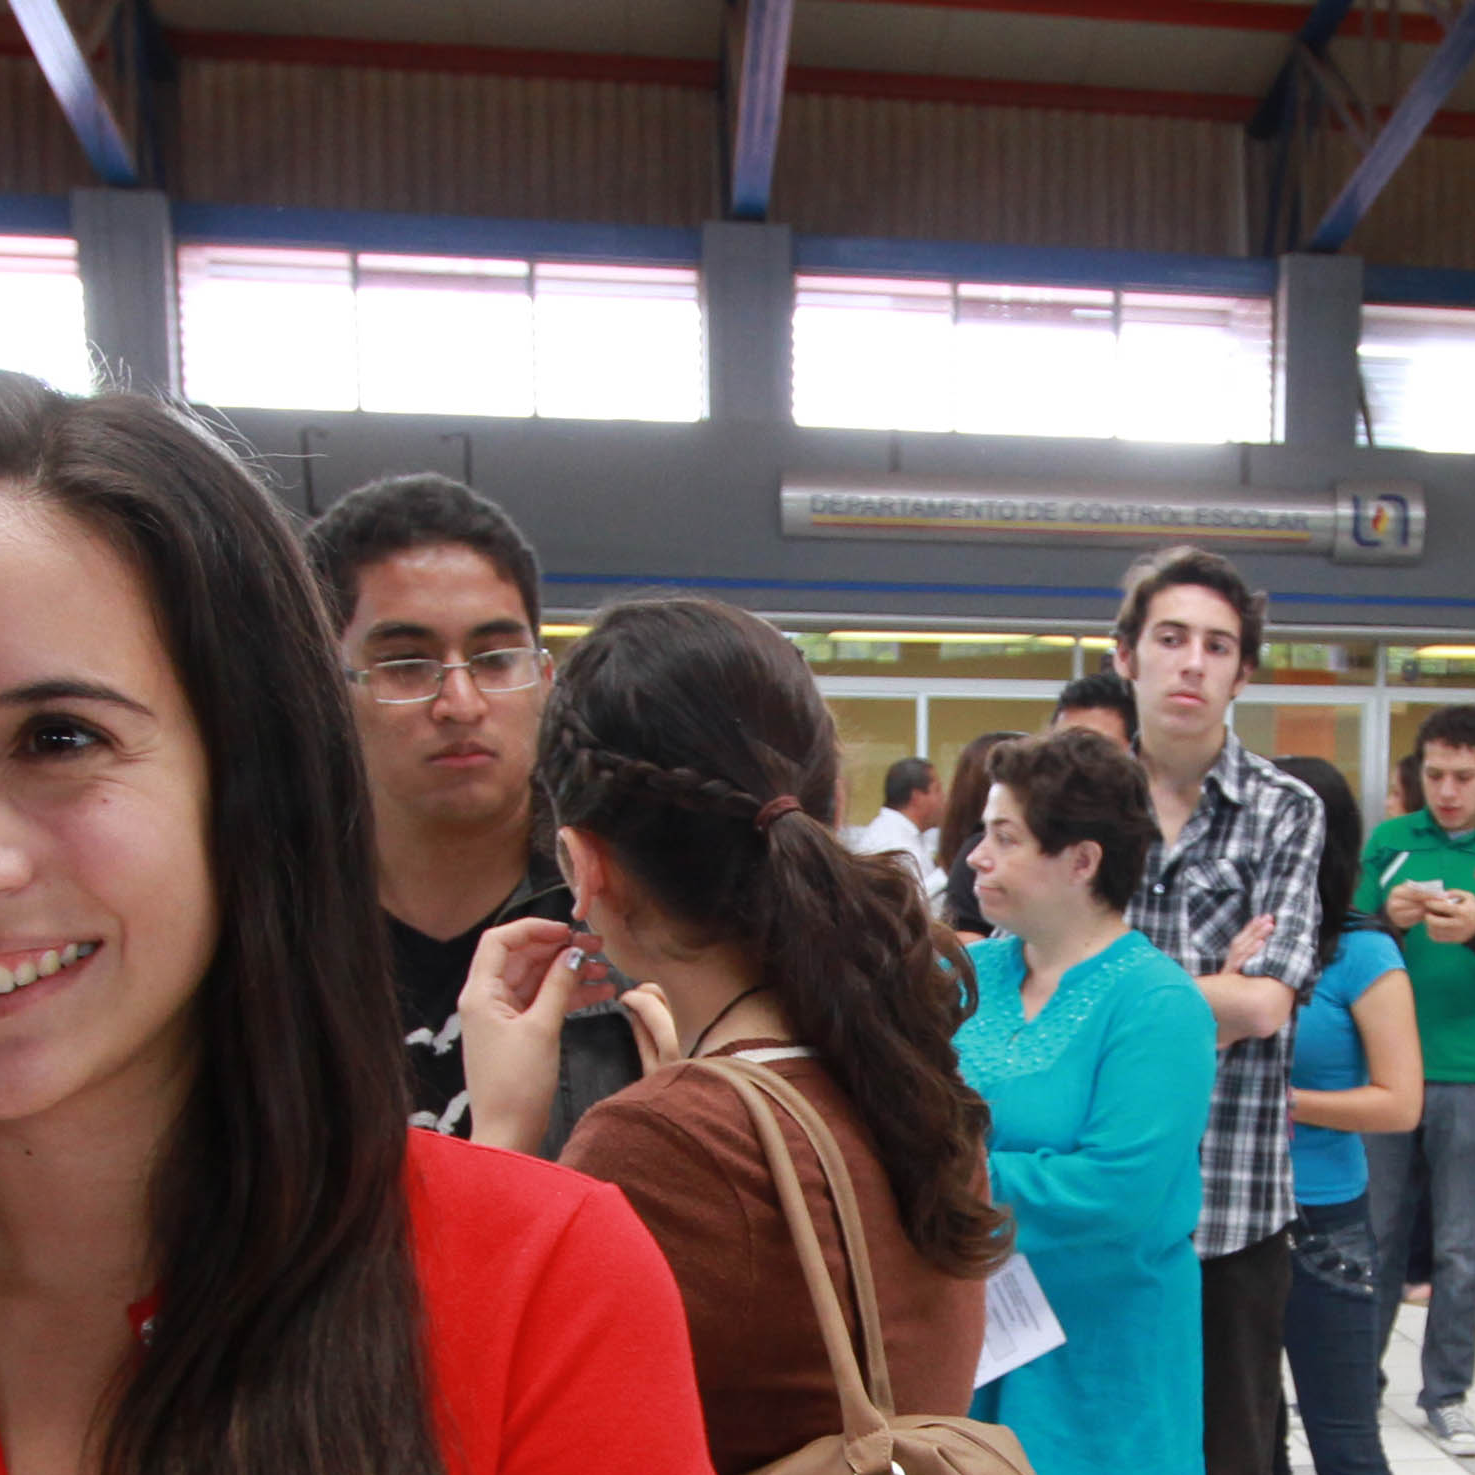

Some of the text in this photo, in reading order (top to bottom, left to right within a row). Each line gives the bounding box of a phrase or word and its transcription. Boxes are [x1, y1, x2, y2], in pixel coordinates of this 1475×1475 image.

[810, 494, 1310, 530] DEPARTAMENTO DE CONTROL ESCOLAR
